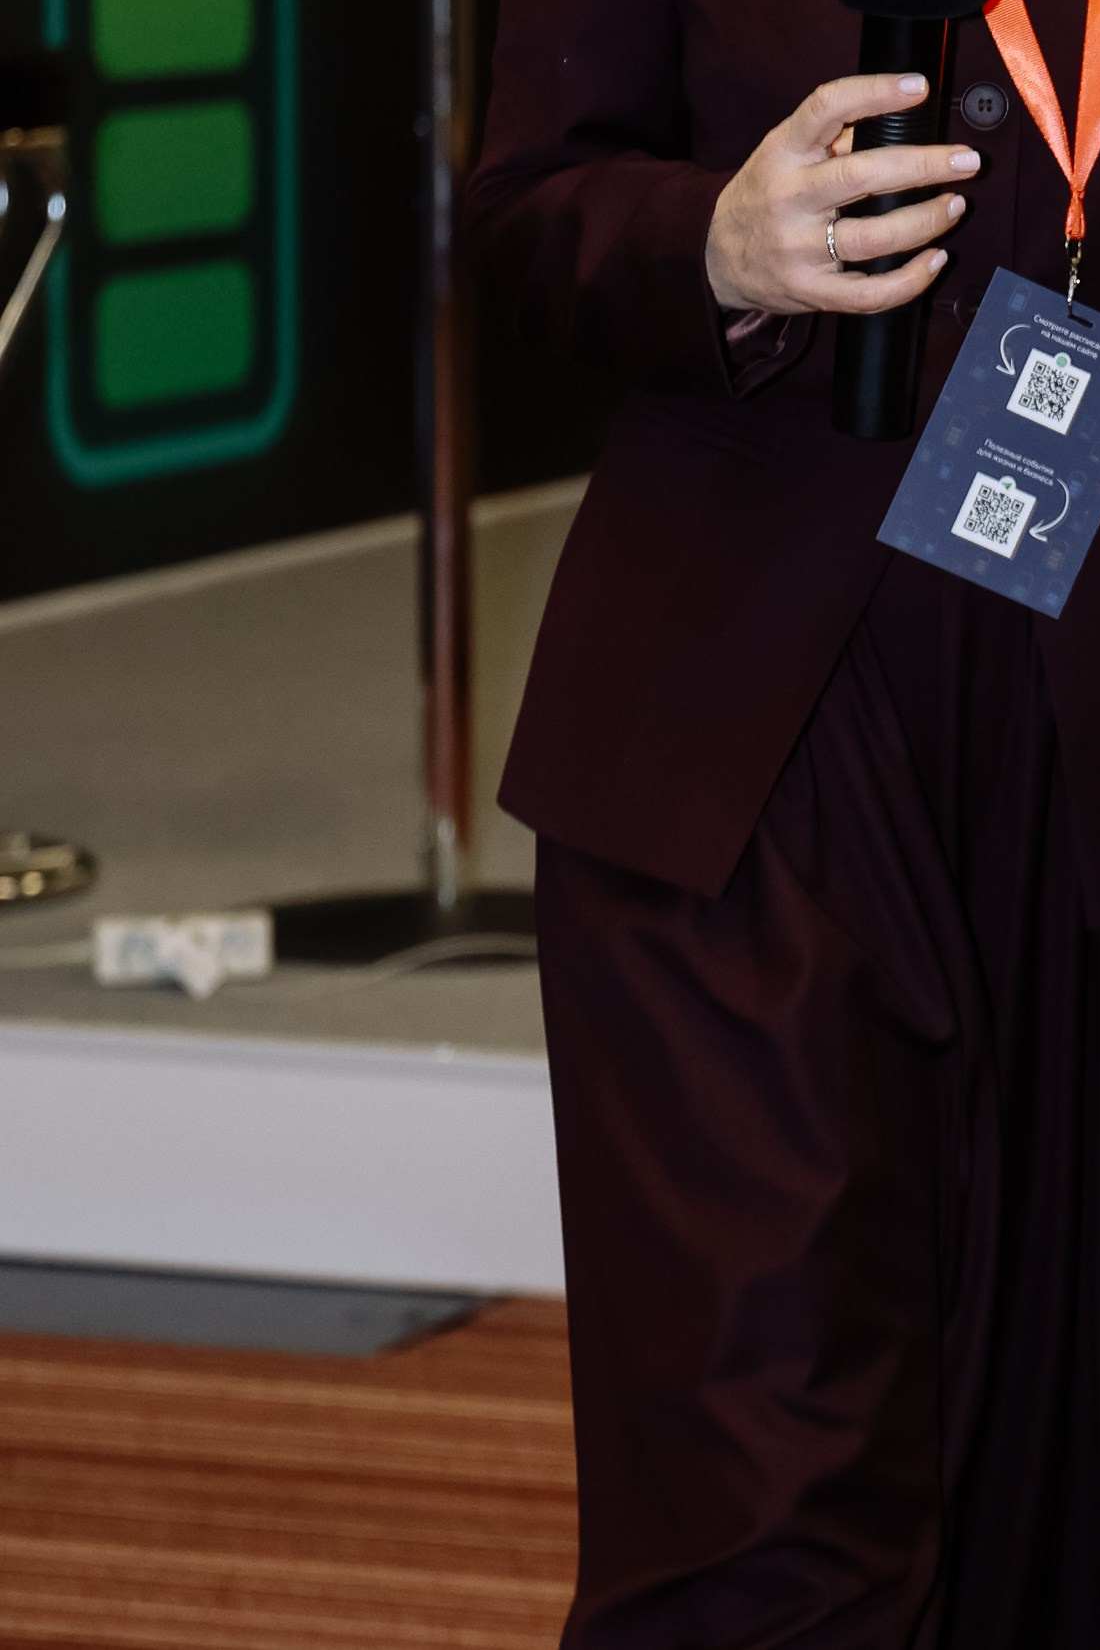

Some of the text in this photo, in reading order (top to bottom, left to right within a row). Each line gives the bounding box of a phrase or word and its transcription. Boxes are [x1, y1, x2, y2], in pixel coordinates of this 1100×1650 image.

[1033, 313, 1070, 336] Смотрите
[1040, 329, 1098, 360] на нашем сайте
[975, 447, 1054, 487] для жизни и бизнеса
[984, 437, 1055, 477] Полезные события
